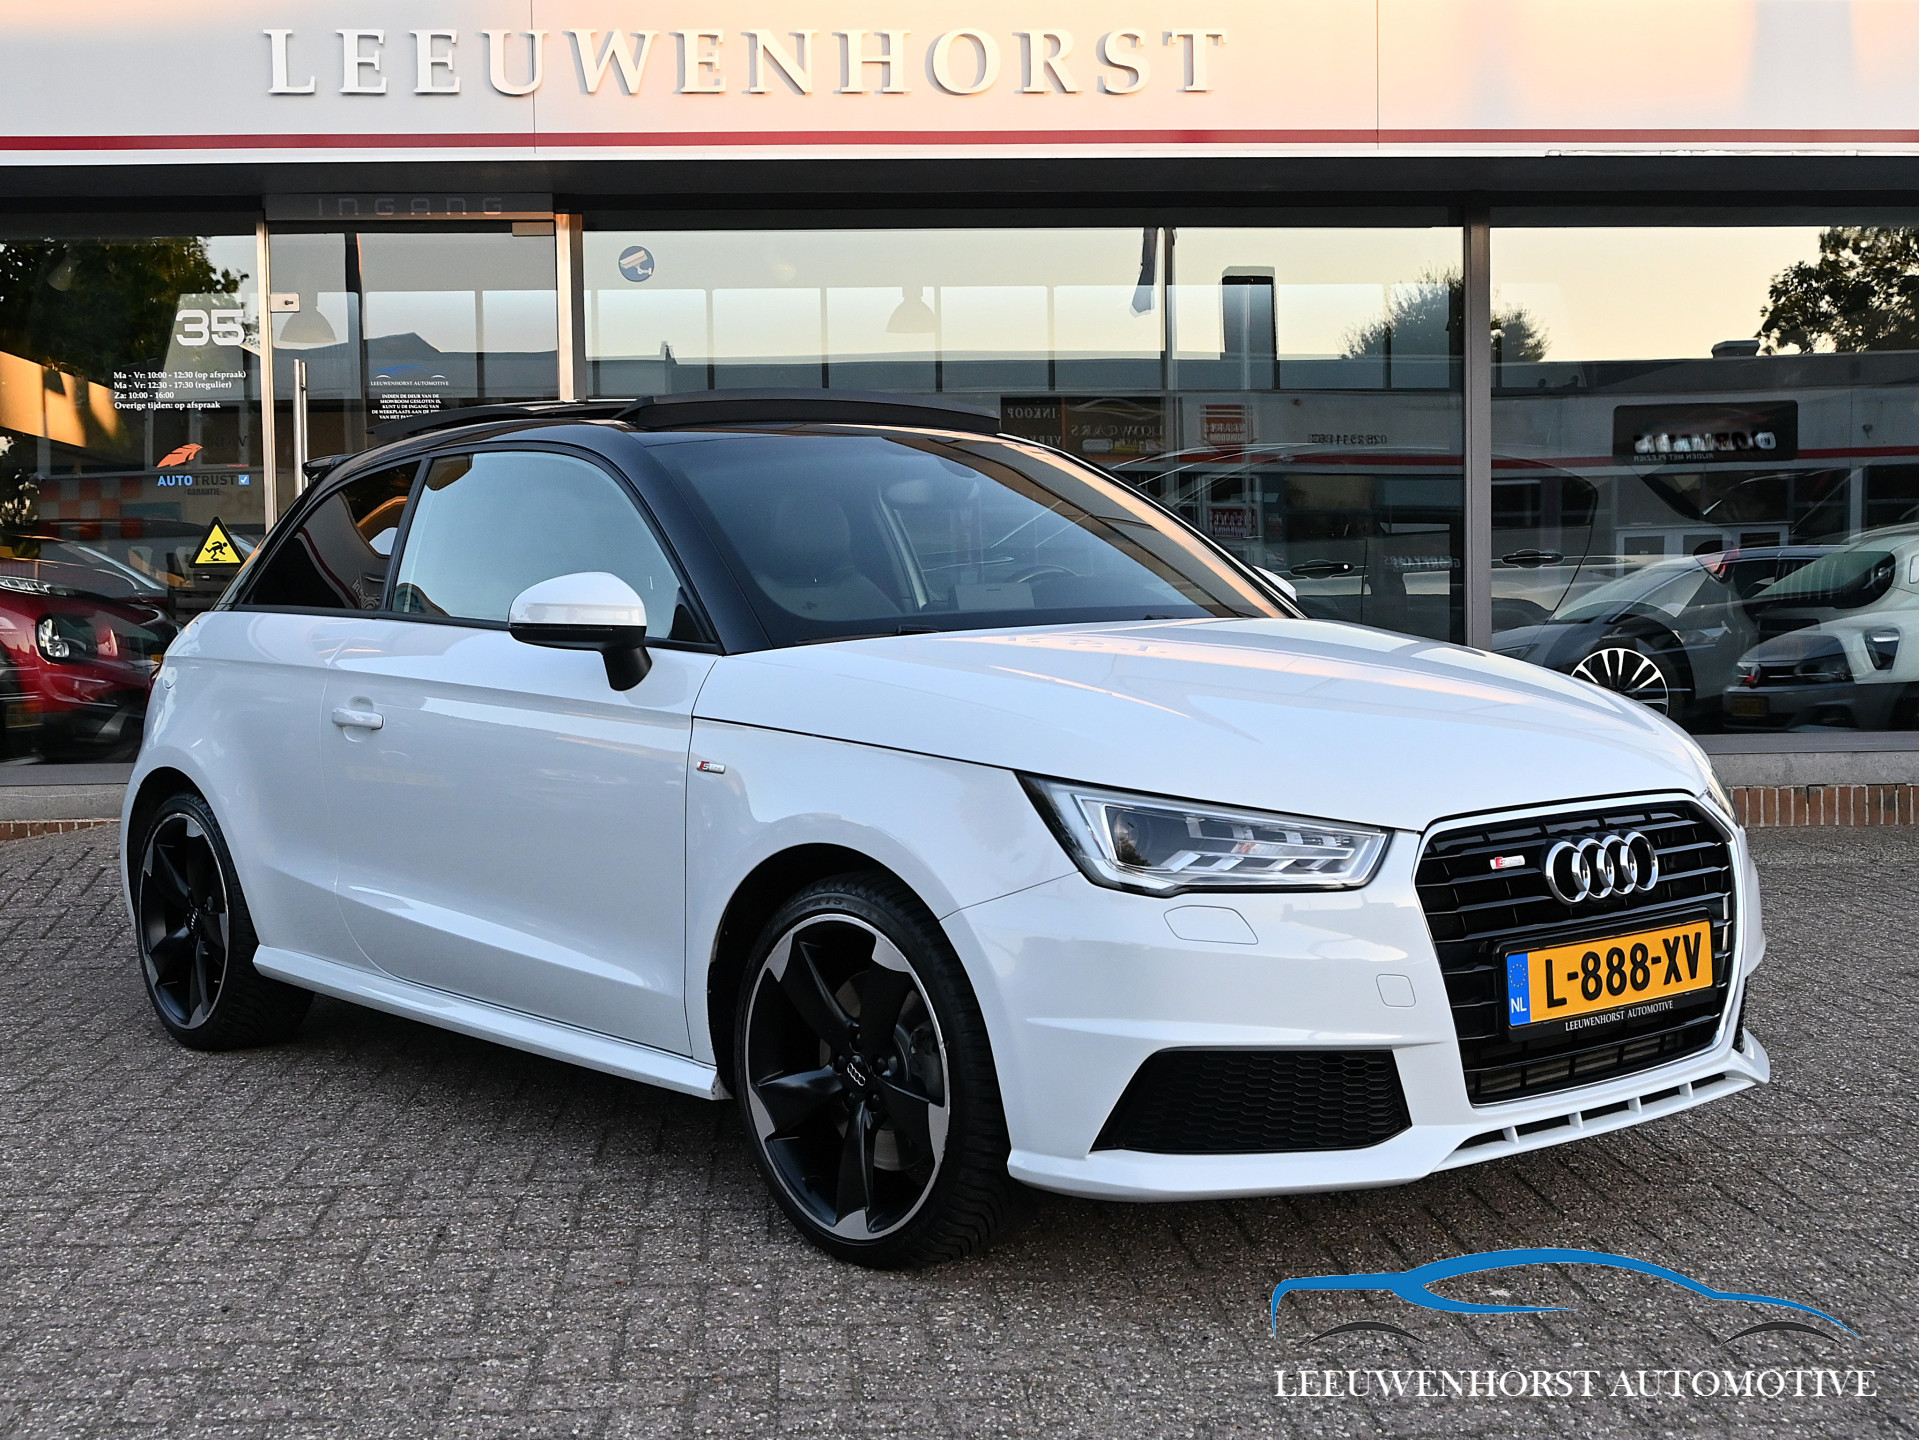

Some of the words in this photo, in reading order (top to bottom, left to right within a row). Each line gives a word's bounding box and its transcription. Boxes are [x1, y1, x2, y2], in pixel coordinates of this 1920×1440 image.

[263, 28, 1228, 97] LEEUWENHORST
[318, 198, 502, 216] INGANG
[175, 309, 245, 346] 35
[113, 371, 127, 379] Ma
[133, 371, 146, 379] Vr:
[147, 371, 167, 379] 10:00
[174, 371, 193, 379] 12:30
[195, 371, 207, 380] (op
[209, 370, 247, 380] afspraak)
[113, 381, 127, 389] Ma
[133, 381, 146, 389] Vr:
[148, 381, 167, 389] 12:30
[174, 381, 194, 389] 17:30
[195, 380, 232, 390] (regulier)
[114, 391, 127, 399] Za:
[128, 391, 148, 399] 10:00
[155, 391, 175, 399] 16:00
[114, 402, 146, 410] Overige
[147, 401, 173, 410] tijden:
[186, 401, 221, 410] afspraak
[157, 474, 236, 486] AUTOTRUST
[1545, 931, 1702, 1009] L-888-XV
[1510, 997, 1528, 1014] NL
[1565, 1010, 1626, 1032] LEEUWENHORST
[1627, 1000, 1674, 1019] AUTOMOTIVE
